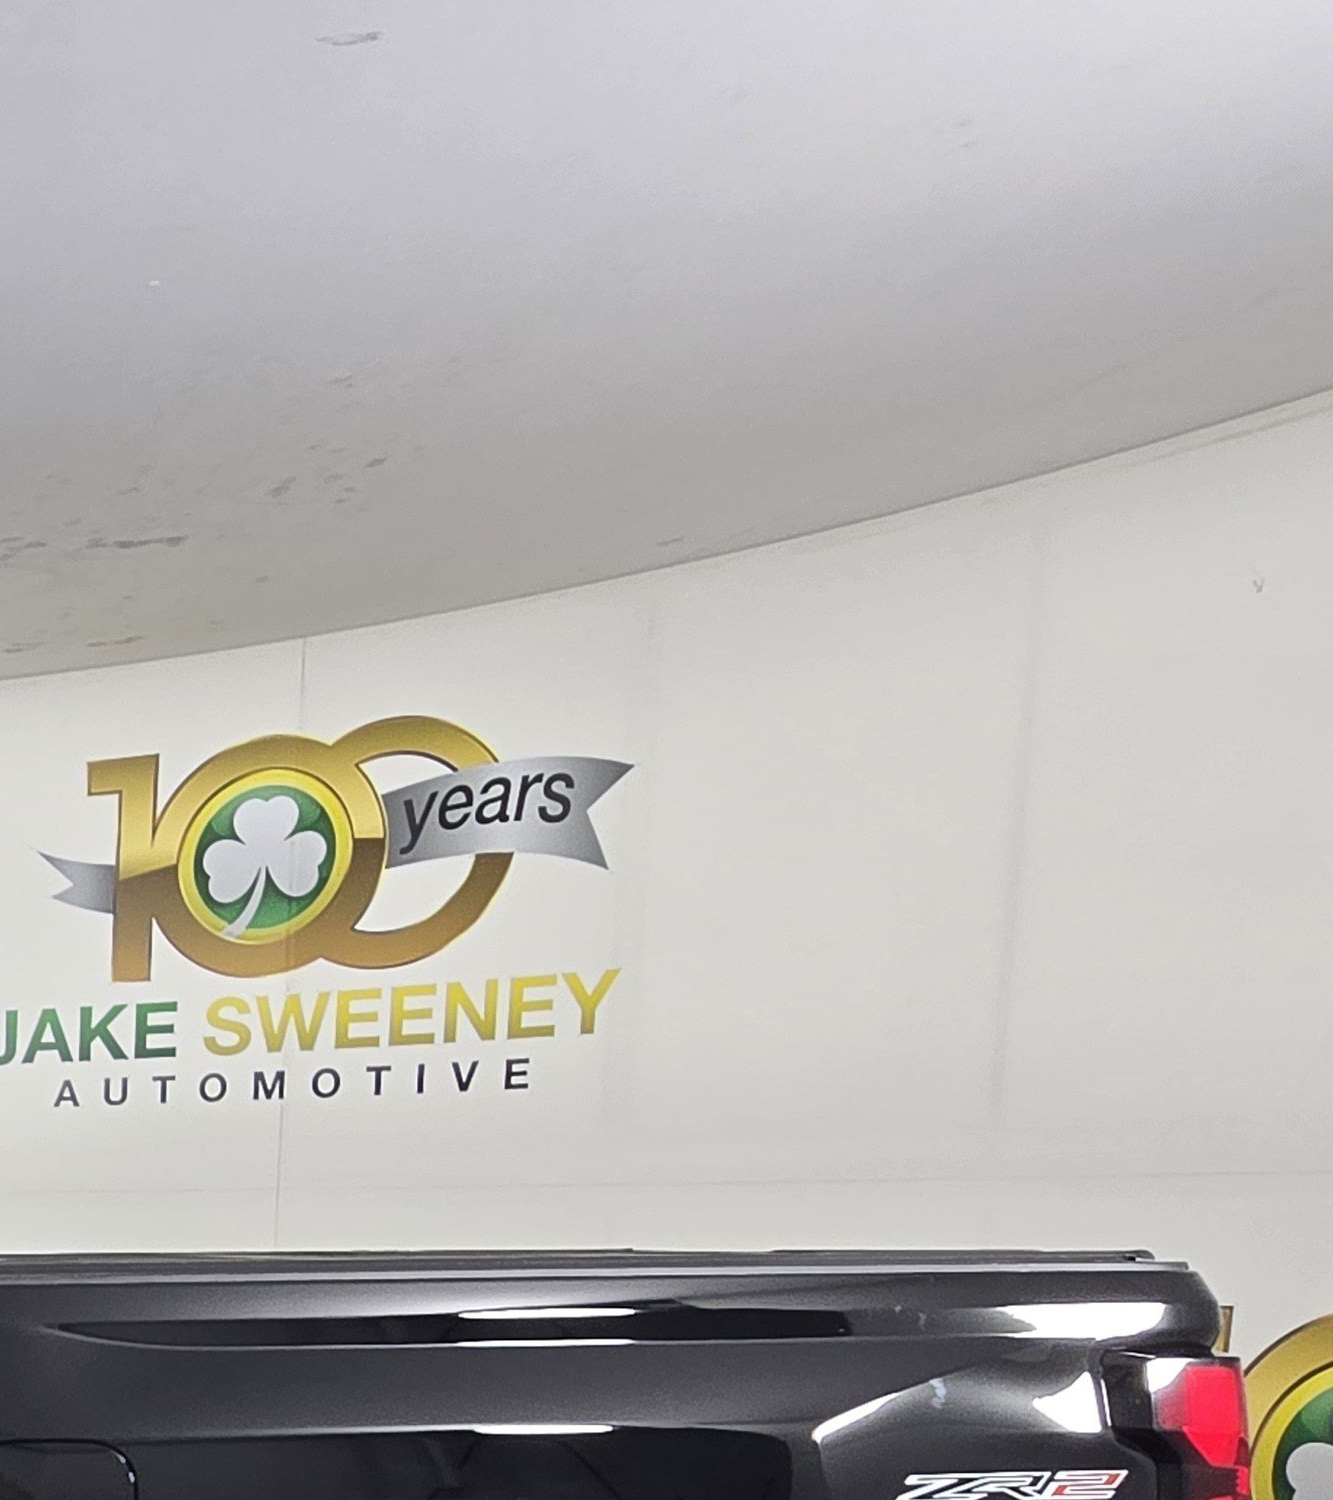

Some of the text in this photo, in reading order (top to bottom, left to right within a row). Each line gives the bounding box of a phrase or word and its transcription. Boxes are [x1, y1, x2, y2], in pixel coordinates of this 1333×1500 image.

[87, 714, 515, 984] 100
[398, 769, 576, 856] years
[201, 966, 623, 1056] SWEENEY
[53, 1057, 531, 1108] AUTOMOTIVE
